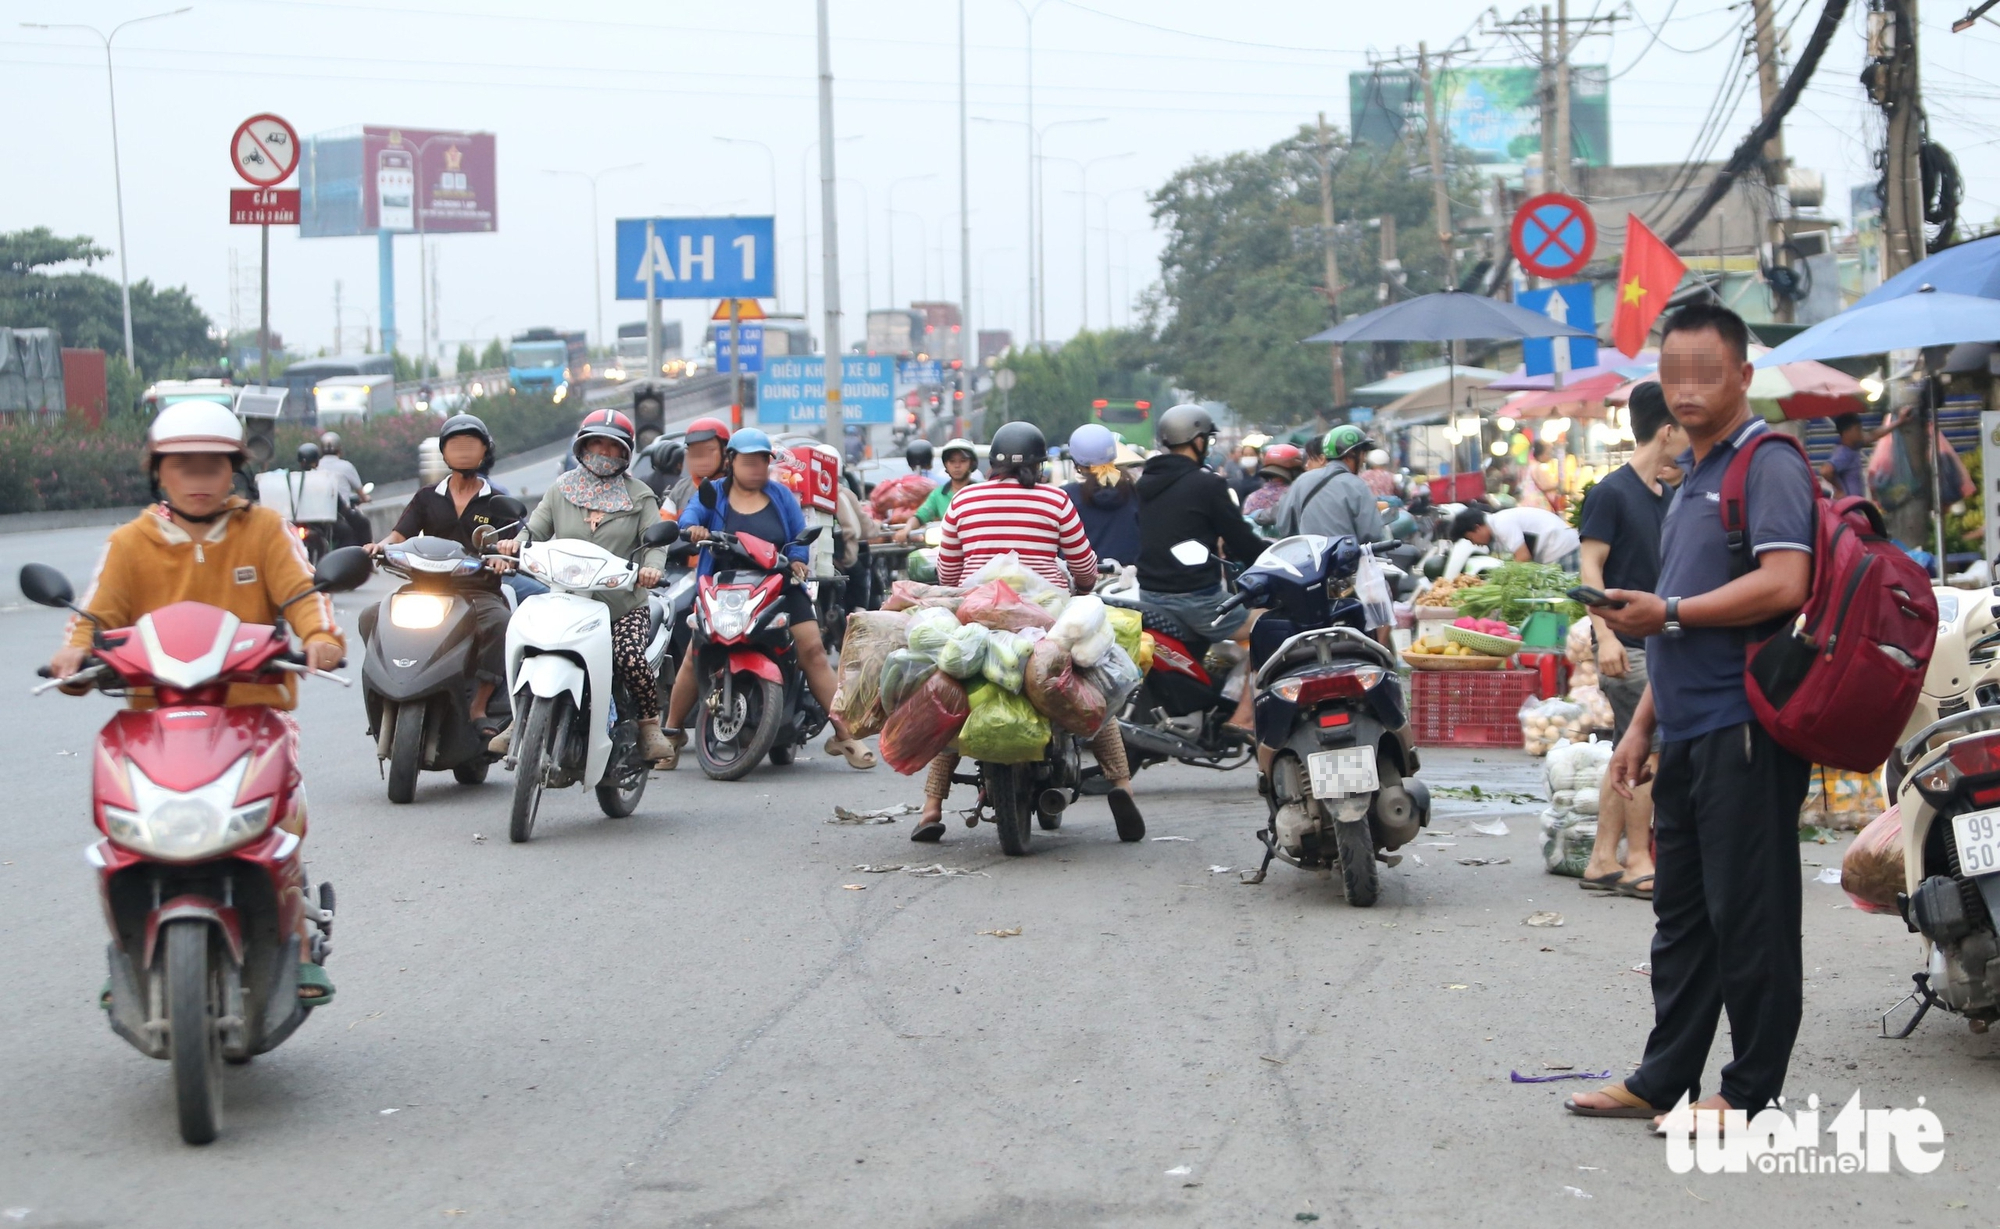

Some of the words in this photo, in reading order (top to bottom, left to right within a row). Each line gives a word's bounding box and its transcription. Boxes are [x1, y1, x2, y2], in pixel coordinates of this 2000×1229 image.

[236, 210, 246, 222] XE
[248, 210, 254, 222] 2
[255, 208, 265, 222] VÀ
[635, 235, 714, 281] AH
[732, 235, 756, 281] 1
[772, 358, 802, 378] ĐIỀU
[848, 361, 865, 378] XE
[867, 361, 881, 378] ĐI
[791, 401, 815, 420] LÀN
